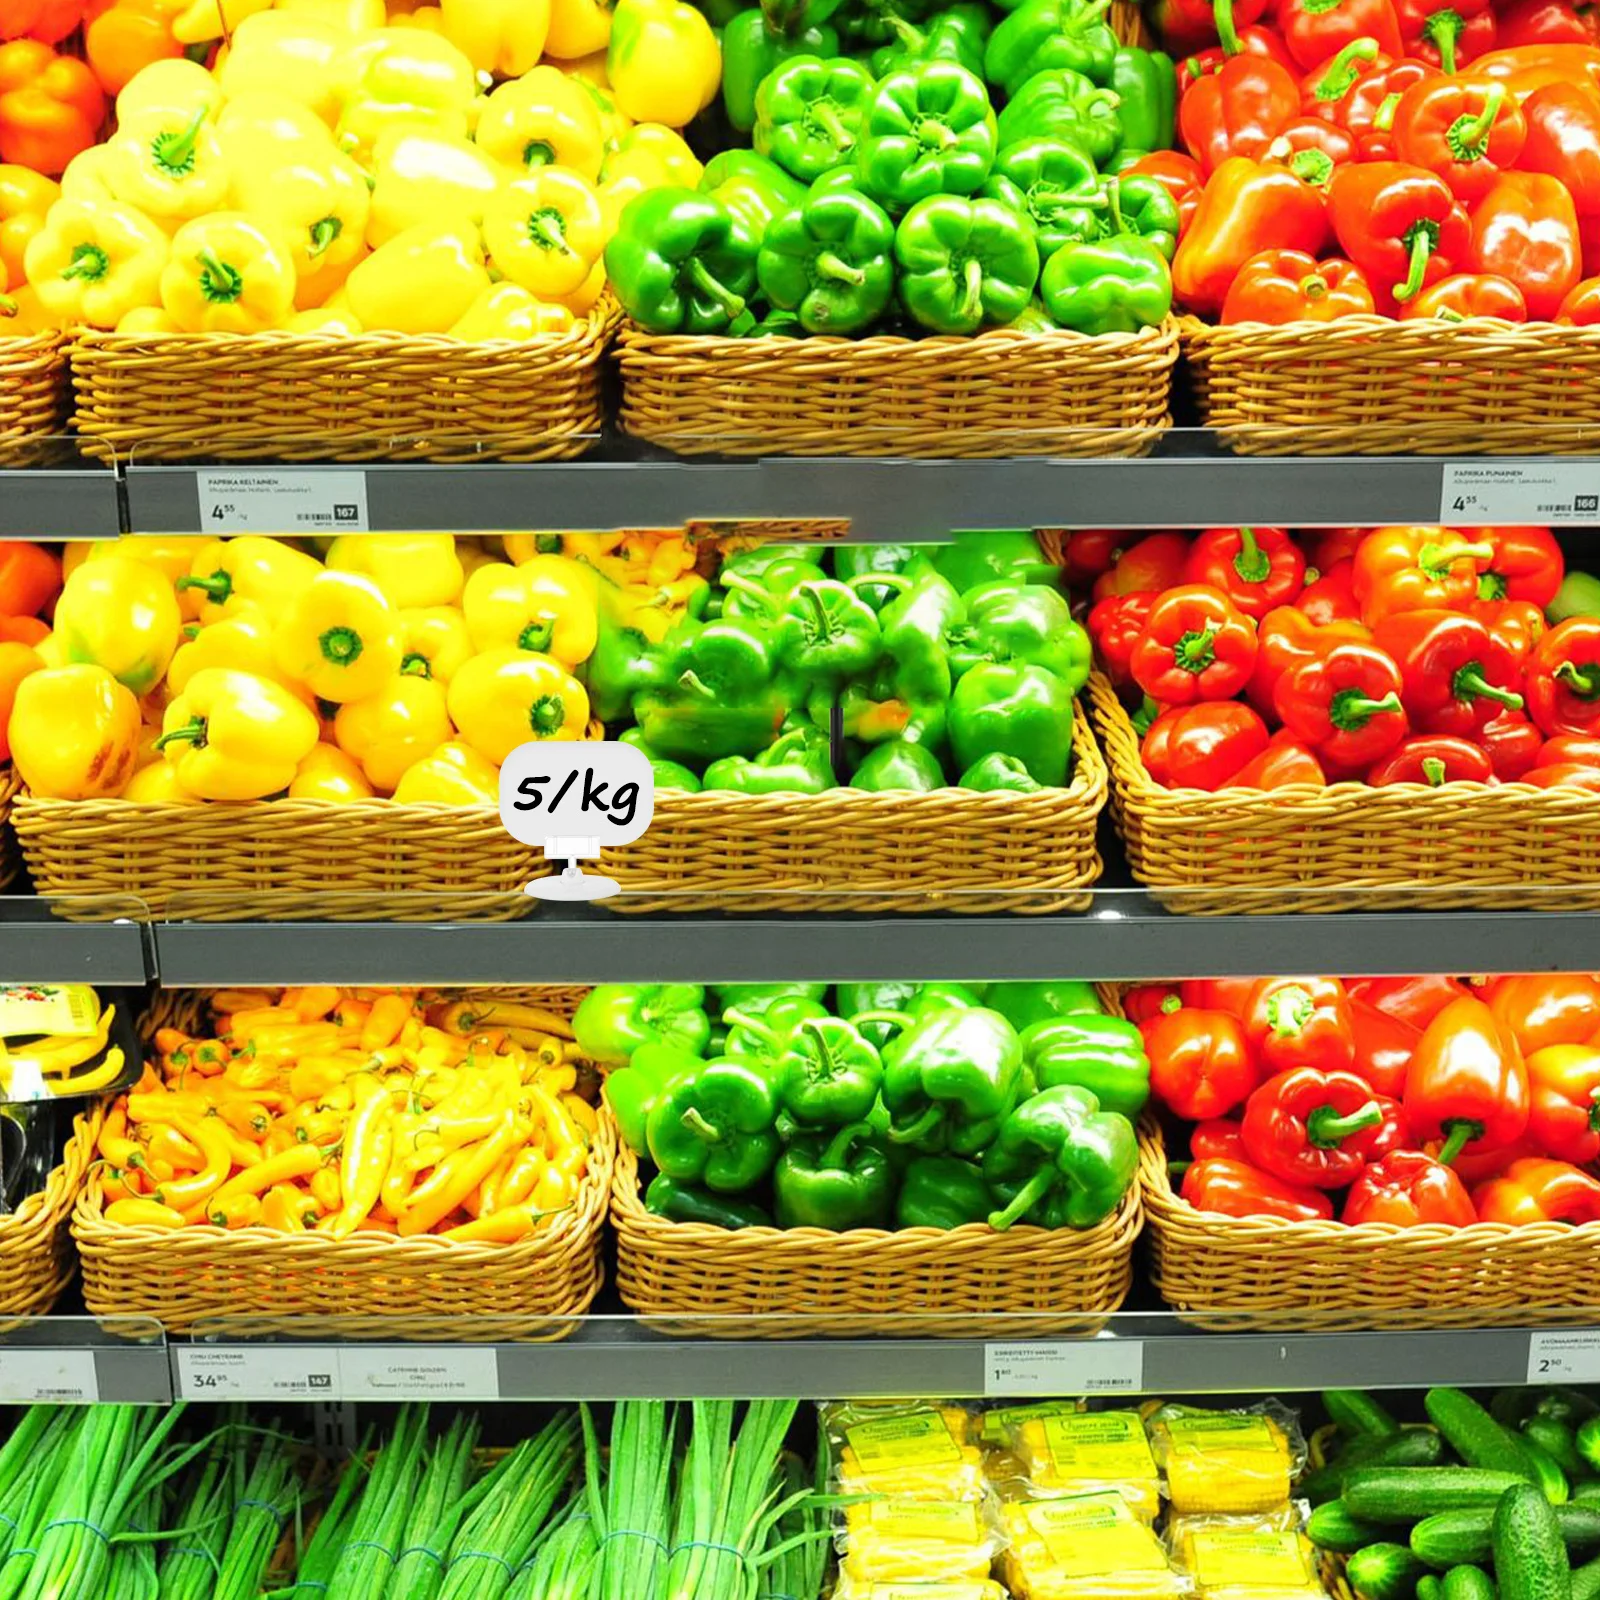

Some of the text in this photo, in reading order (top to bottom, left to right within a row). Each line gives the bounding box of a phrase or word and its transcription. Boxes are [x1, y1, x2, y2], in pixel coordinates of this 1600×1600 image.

[1577, 499, 1596, 508] 166
[336, 507, 354, 518] 167
[513, 767, 640, 826] 5/kg
